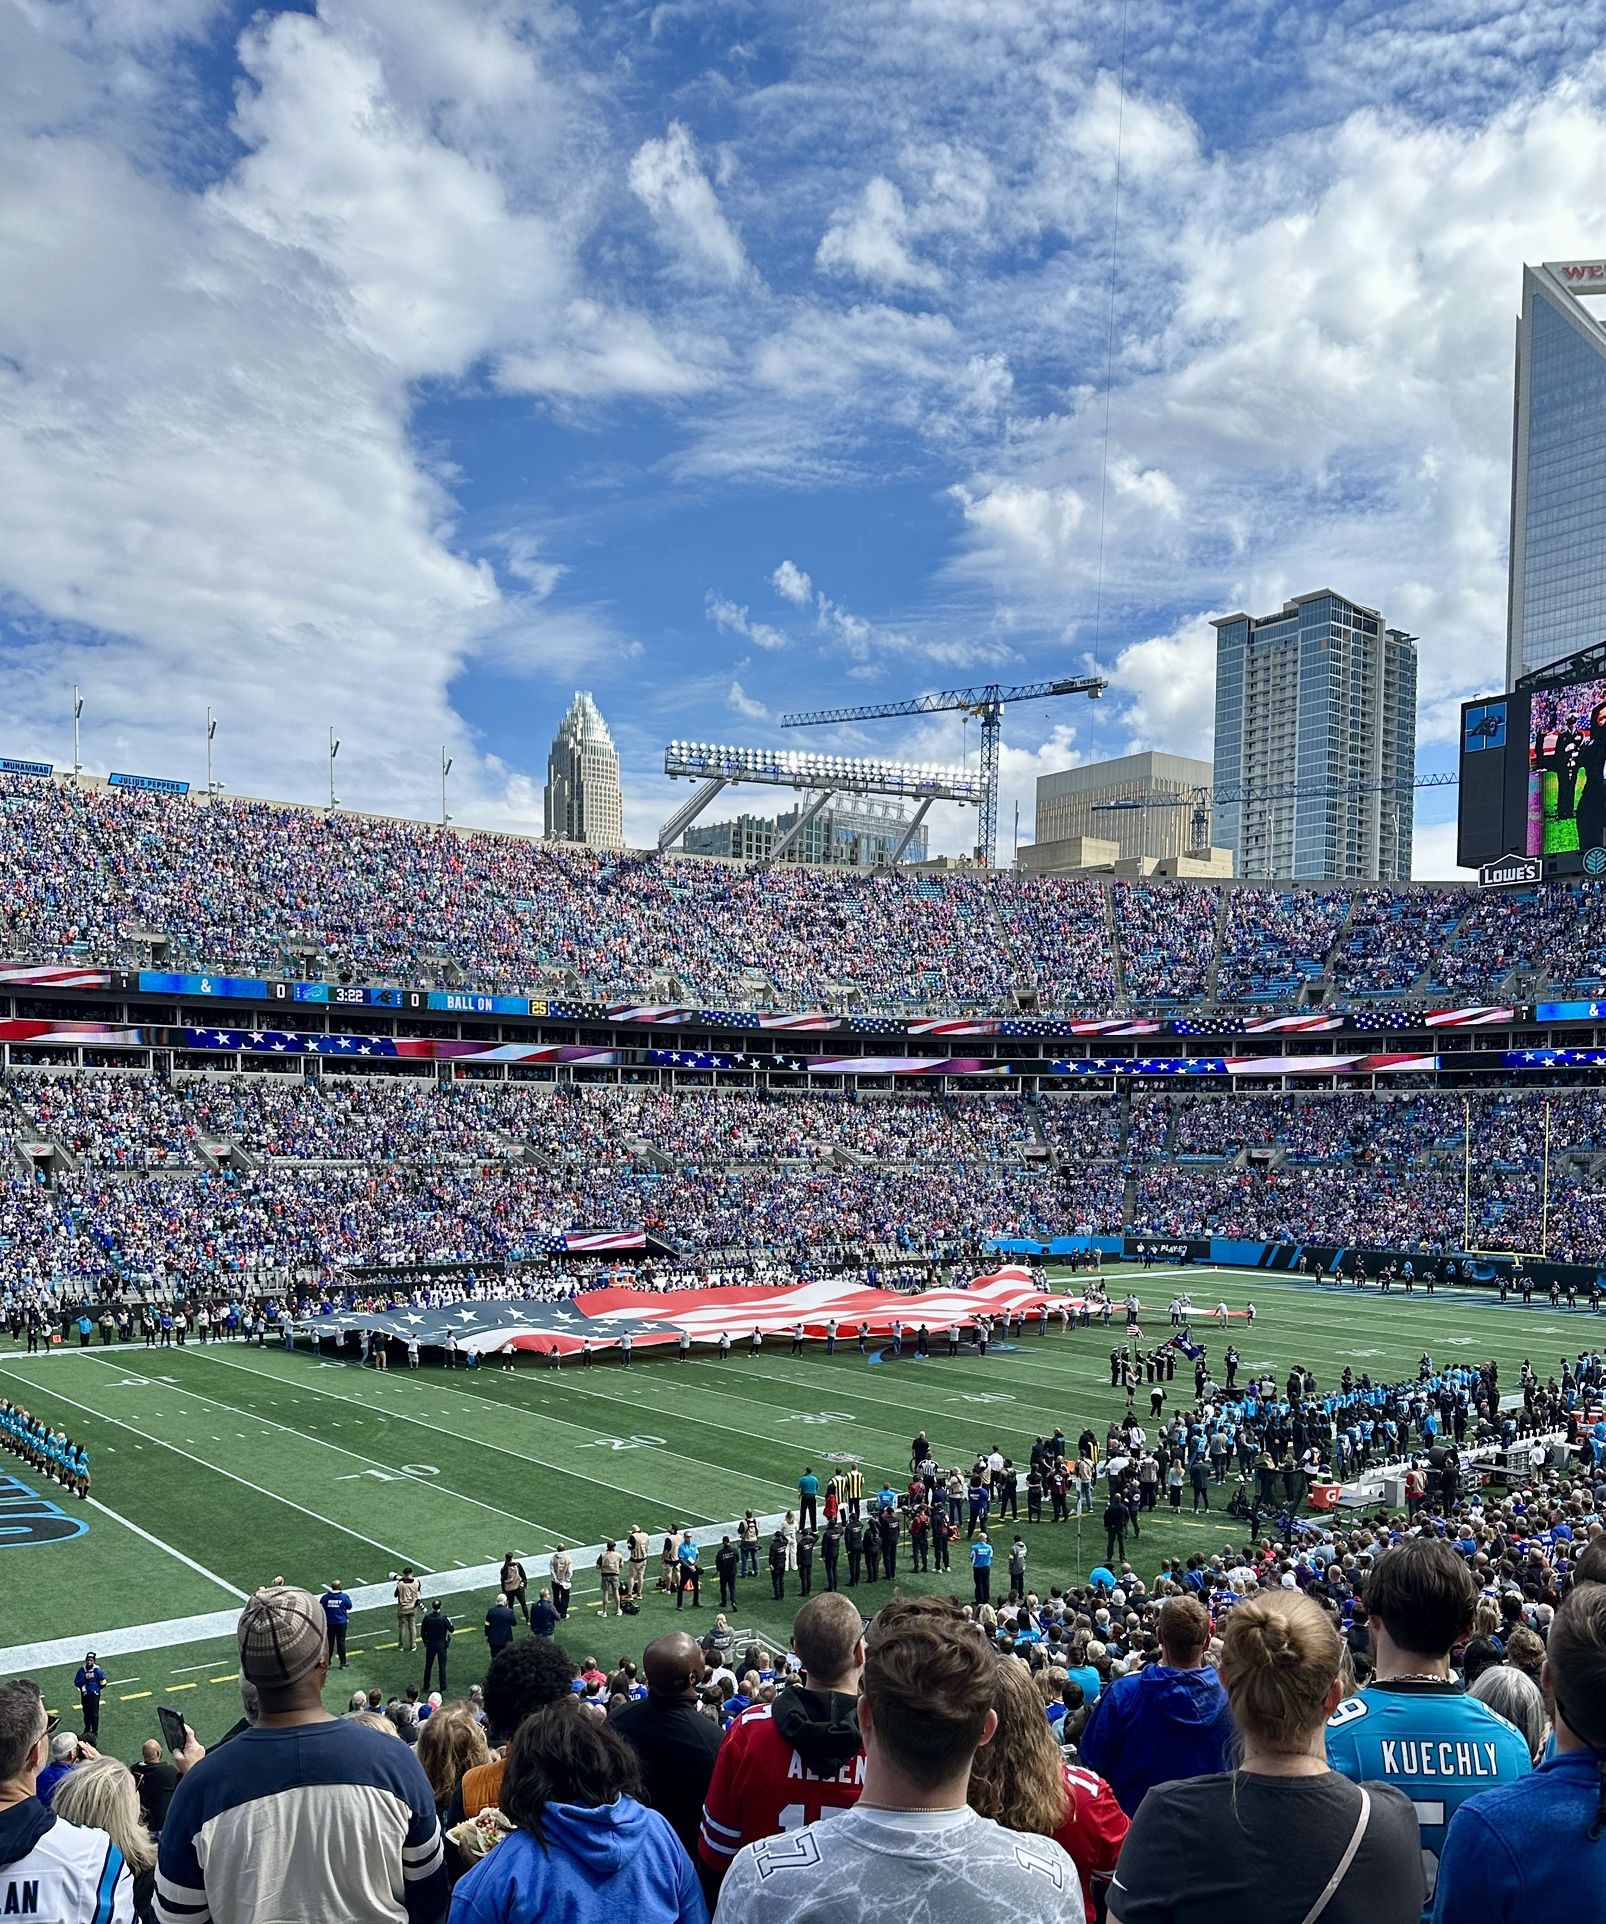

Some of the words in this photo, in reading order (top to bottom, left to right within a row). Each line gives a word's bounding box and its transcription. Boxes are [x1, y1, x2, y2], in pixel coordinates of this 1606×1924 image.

[3, 761, 48, 774] MUHAMMAD
[118, 777, 145, 787] JULIUS
[147, 779, 181, 791] PEPPERS
[1484, 864, 1536, 883] LOWE'S
[276, 984, 286, 999] 0
[336, 988, 363, 1003] 3:22
[411, 993, 419, 1007] 0
[447, 996, 475, 1010] BALL
[477, 998, 493, 1011] ON
[531, 1001, 547, 1015] 25
[594, 1434, 668, 1452] 20
[1325, 1489, 1337, 1502] G
[1381, 1740, 1499, 1777] KUECHLY
[0, 1880, 40, 1915] AN
